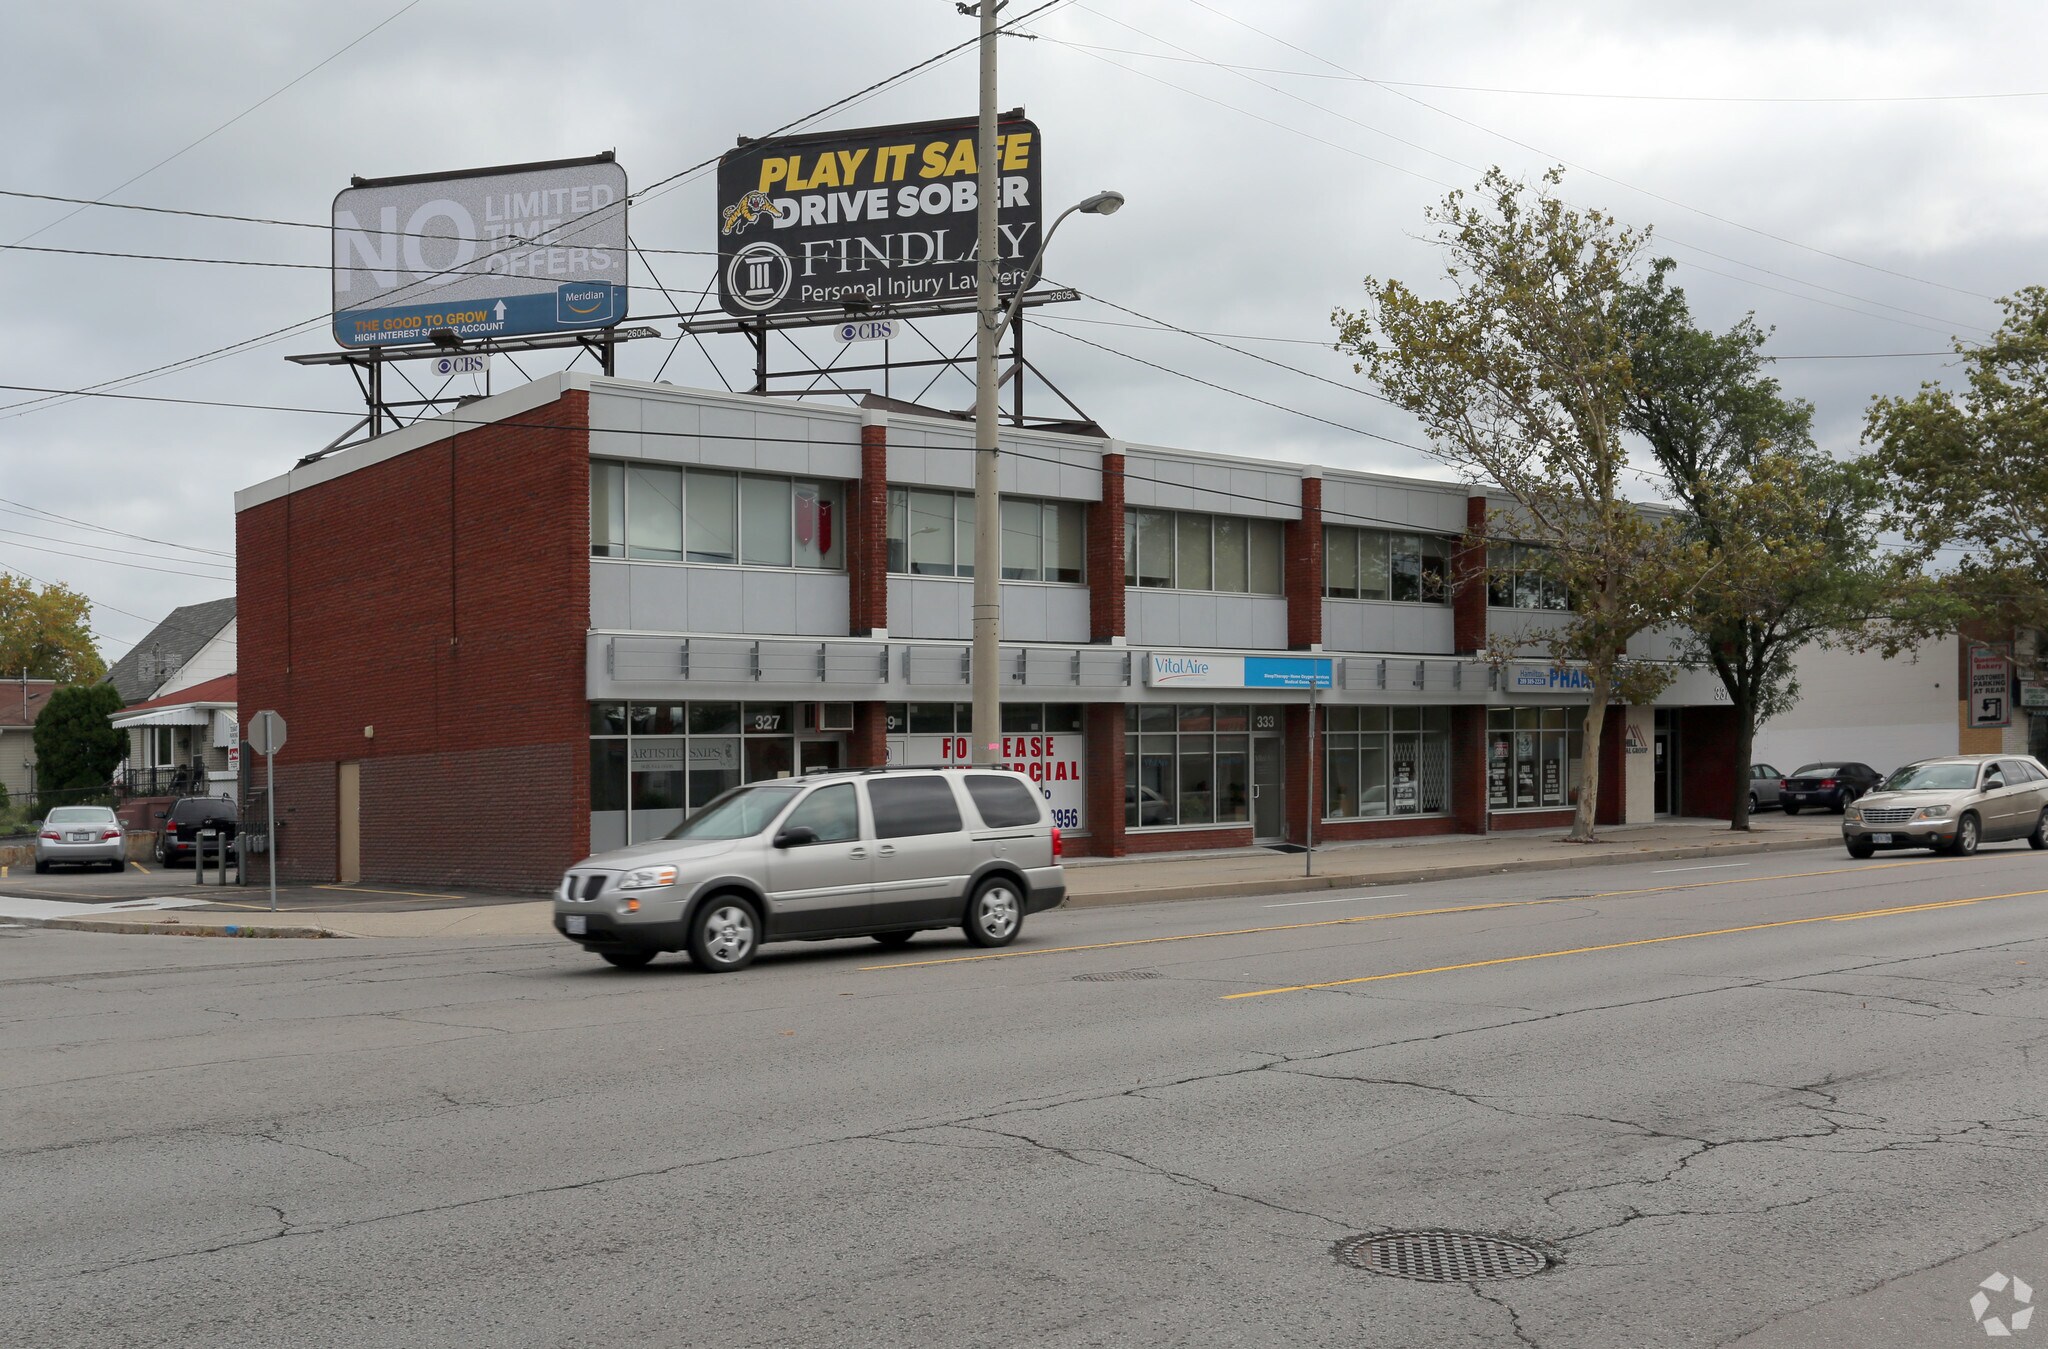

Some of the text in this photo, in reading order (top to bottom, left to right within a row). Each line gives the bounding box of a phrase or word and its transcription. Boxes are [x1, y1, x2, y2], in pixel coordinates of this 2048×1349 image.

[758, 148, 870, 193] PLAY
[873, 144, 916, 183] IT
[485, 184, 614, 222] LIMITED
[773, 175, 1031, 229] DRIVE SOBR
[484, 218, 561, 251] TIME
[334, 199, 477, 293] NO
[485, 244, 619, 280] OFFERS.
[565, 291, 605, 302] Meridian
[801, 277, 882, 303] Personal
[888, 275, 944, 299] Injury
[1051, 291, 1072, 301] 2605
[354, 310, 488, 333] THE GOOD TO GROW
[354, 332, 377, 342] HIGH
[378, 328, 420, 341] INTEREST
[461, 321, 505, 334] ACCOUNT
[859, 321, 892, 340] CBS
[627, 328, 647, 338] 2604
[453, 355, 483, 373] CBS
[1155, 657, 1209, 675] VitalAire
[1521, 669, 1545, 677] Hamilton
[755, 714, 780, 730] 327
[1256, 715, 1275, 728] 333
[631, 747, 721, 759] ARTISTIC SNIPS
[943, 736, 1054, 759] FO EASE
